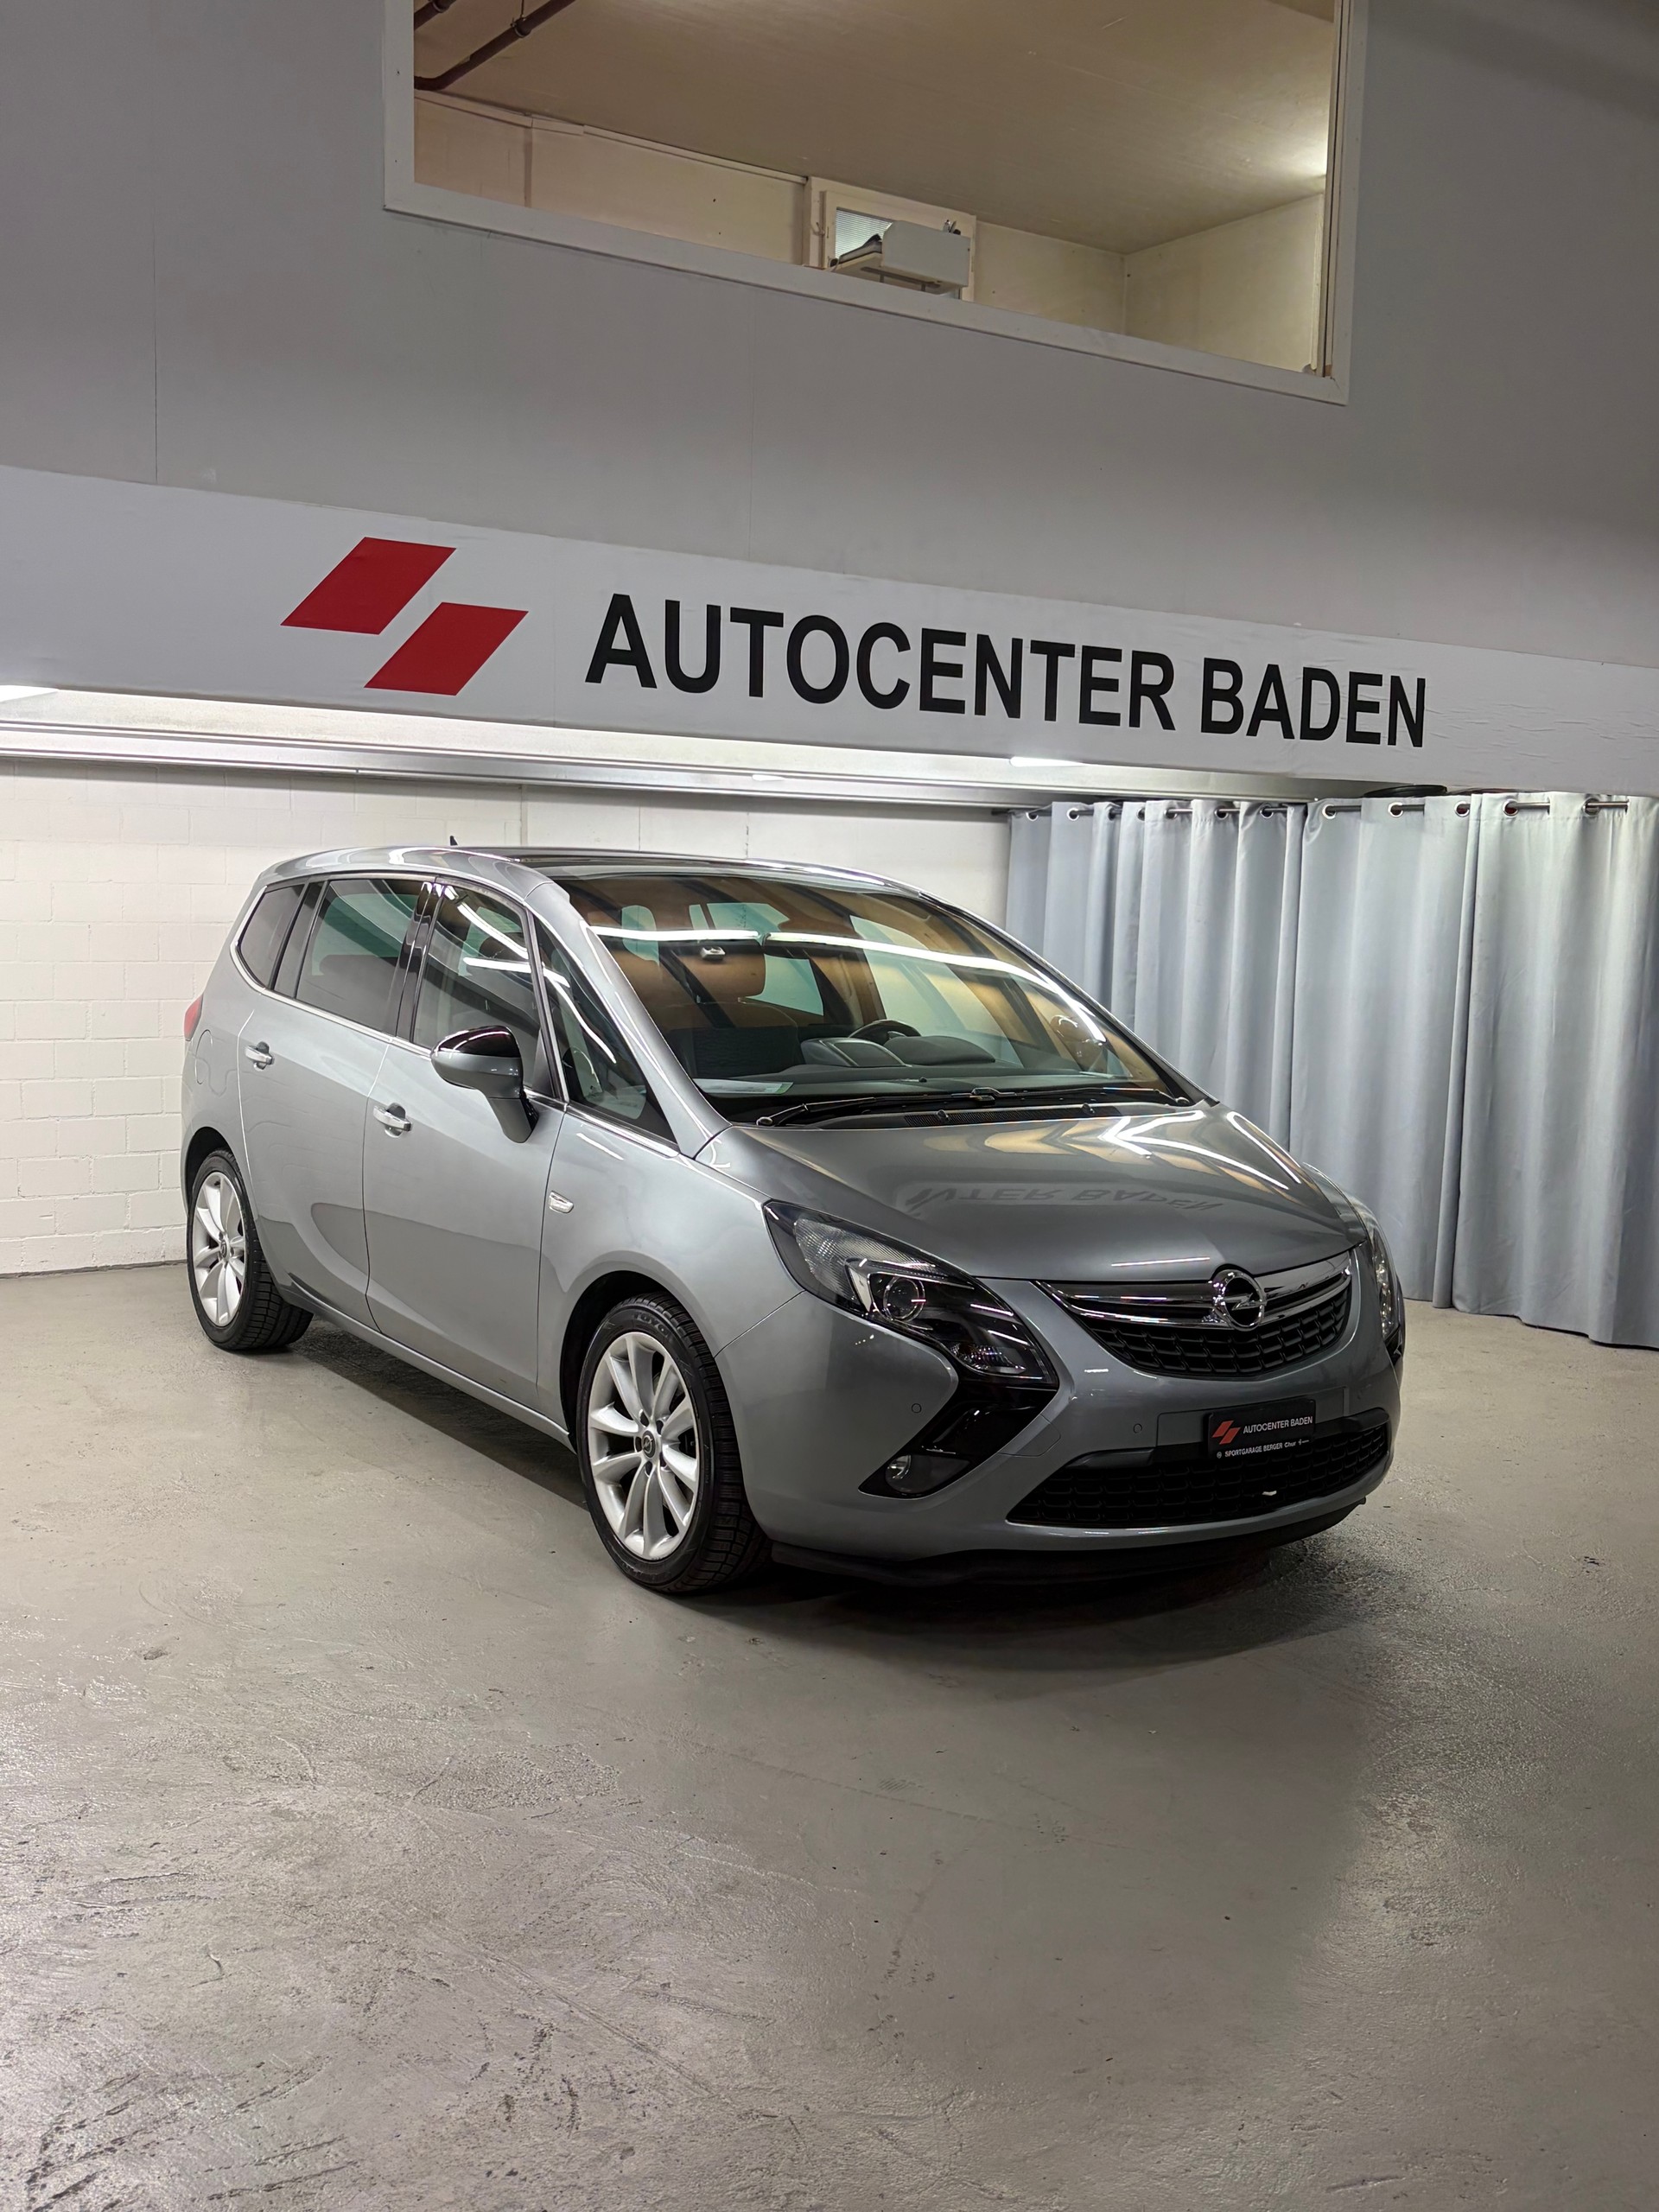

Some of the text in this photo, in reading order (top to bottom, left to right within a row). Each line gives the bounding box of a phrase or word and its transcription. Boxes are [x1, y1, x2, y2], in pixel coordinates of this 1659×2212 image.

[585, 593, 1426, 748] AUTOCENTER BADEN
[1243, 1416, 1313, 1434] AUTOCENTER BADEN
[1224, 1446, 1262, 1458] SPORTGARAGE
[1262, 1442, 1283, 1452] BERGER
